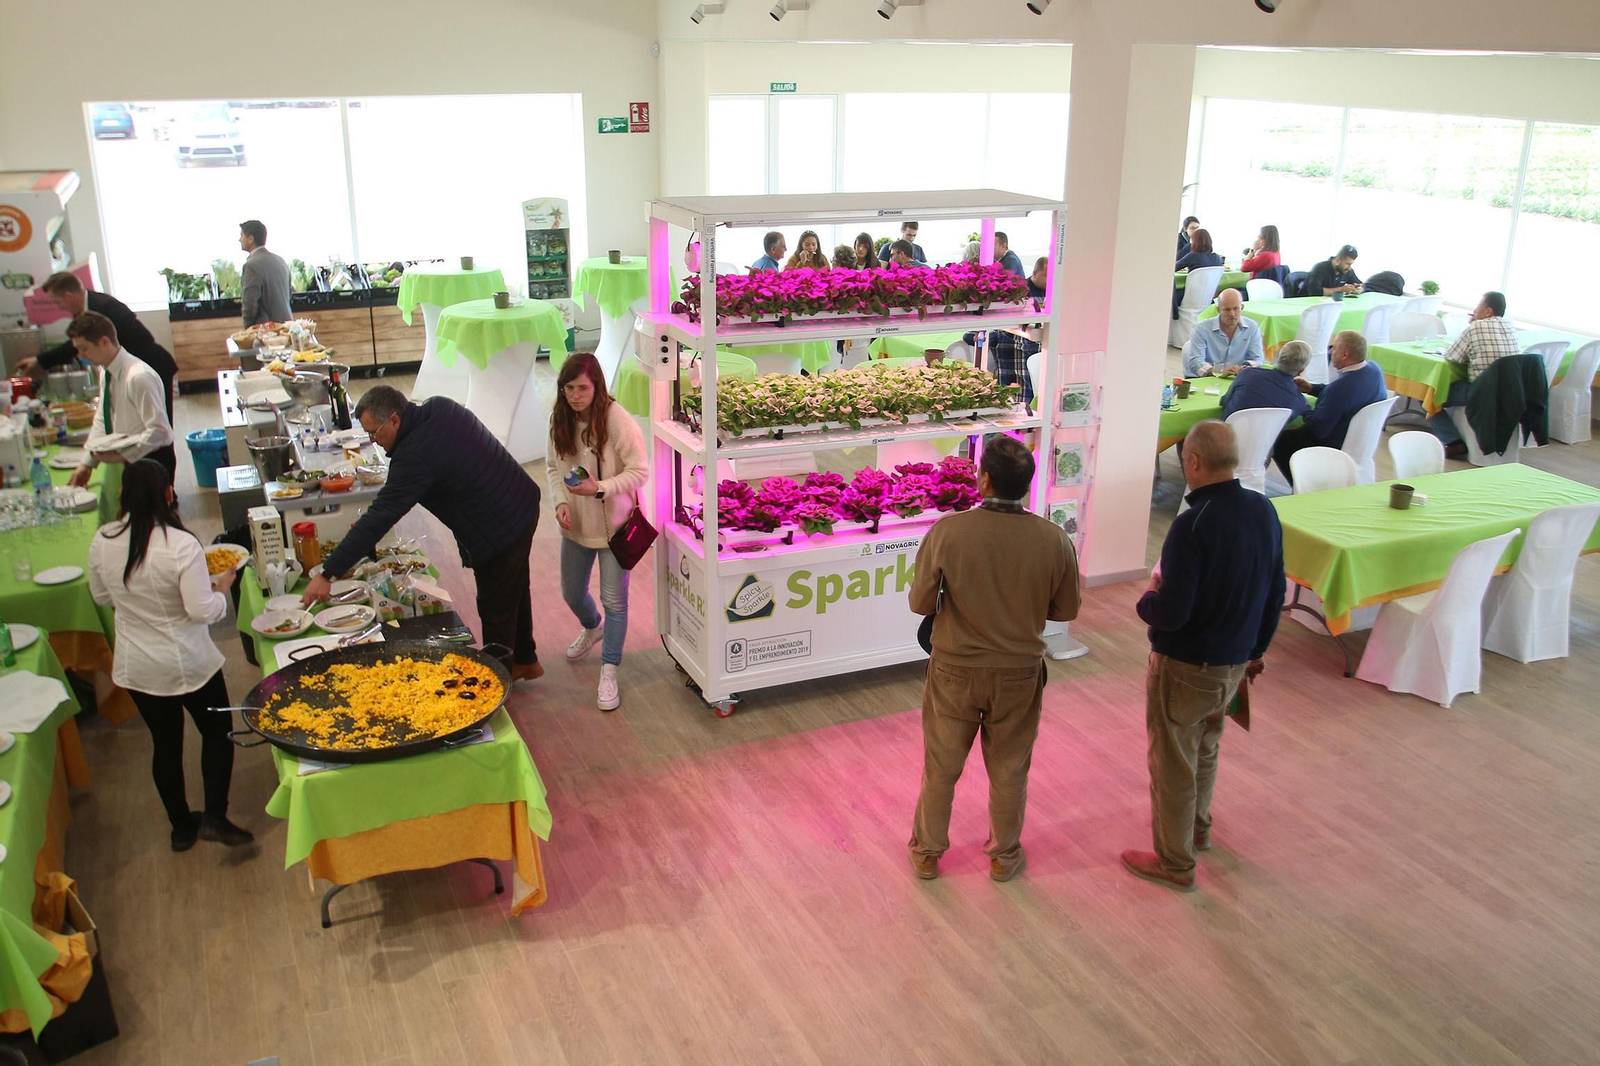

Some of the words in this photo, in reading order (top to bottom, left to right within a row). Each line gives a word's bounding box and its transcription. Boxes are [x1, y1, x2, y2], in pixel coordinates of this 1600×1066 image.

[886, 541, 919, 550] NOVAGRIC
[739, 585, 762, 604] Spicy
[744, 591, 770, 614] Sparkle
[749, 646, 765, 655] PREMIO
[778, 640, 803, 649] INNOVACIÓN
[759, 648, 797, 660] EMPRENDIMIENTO
